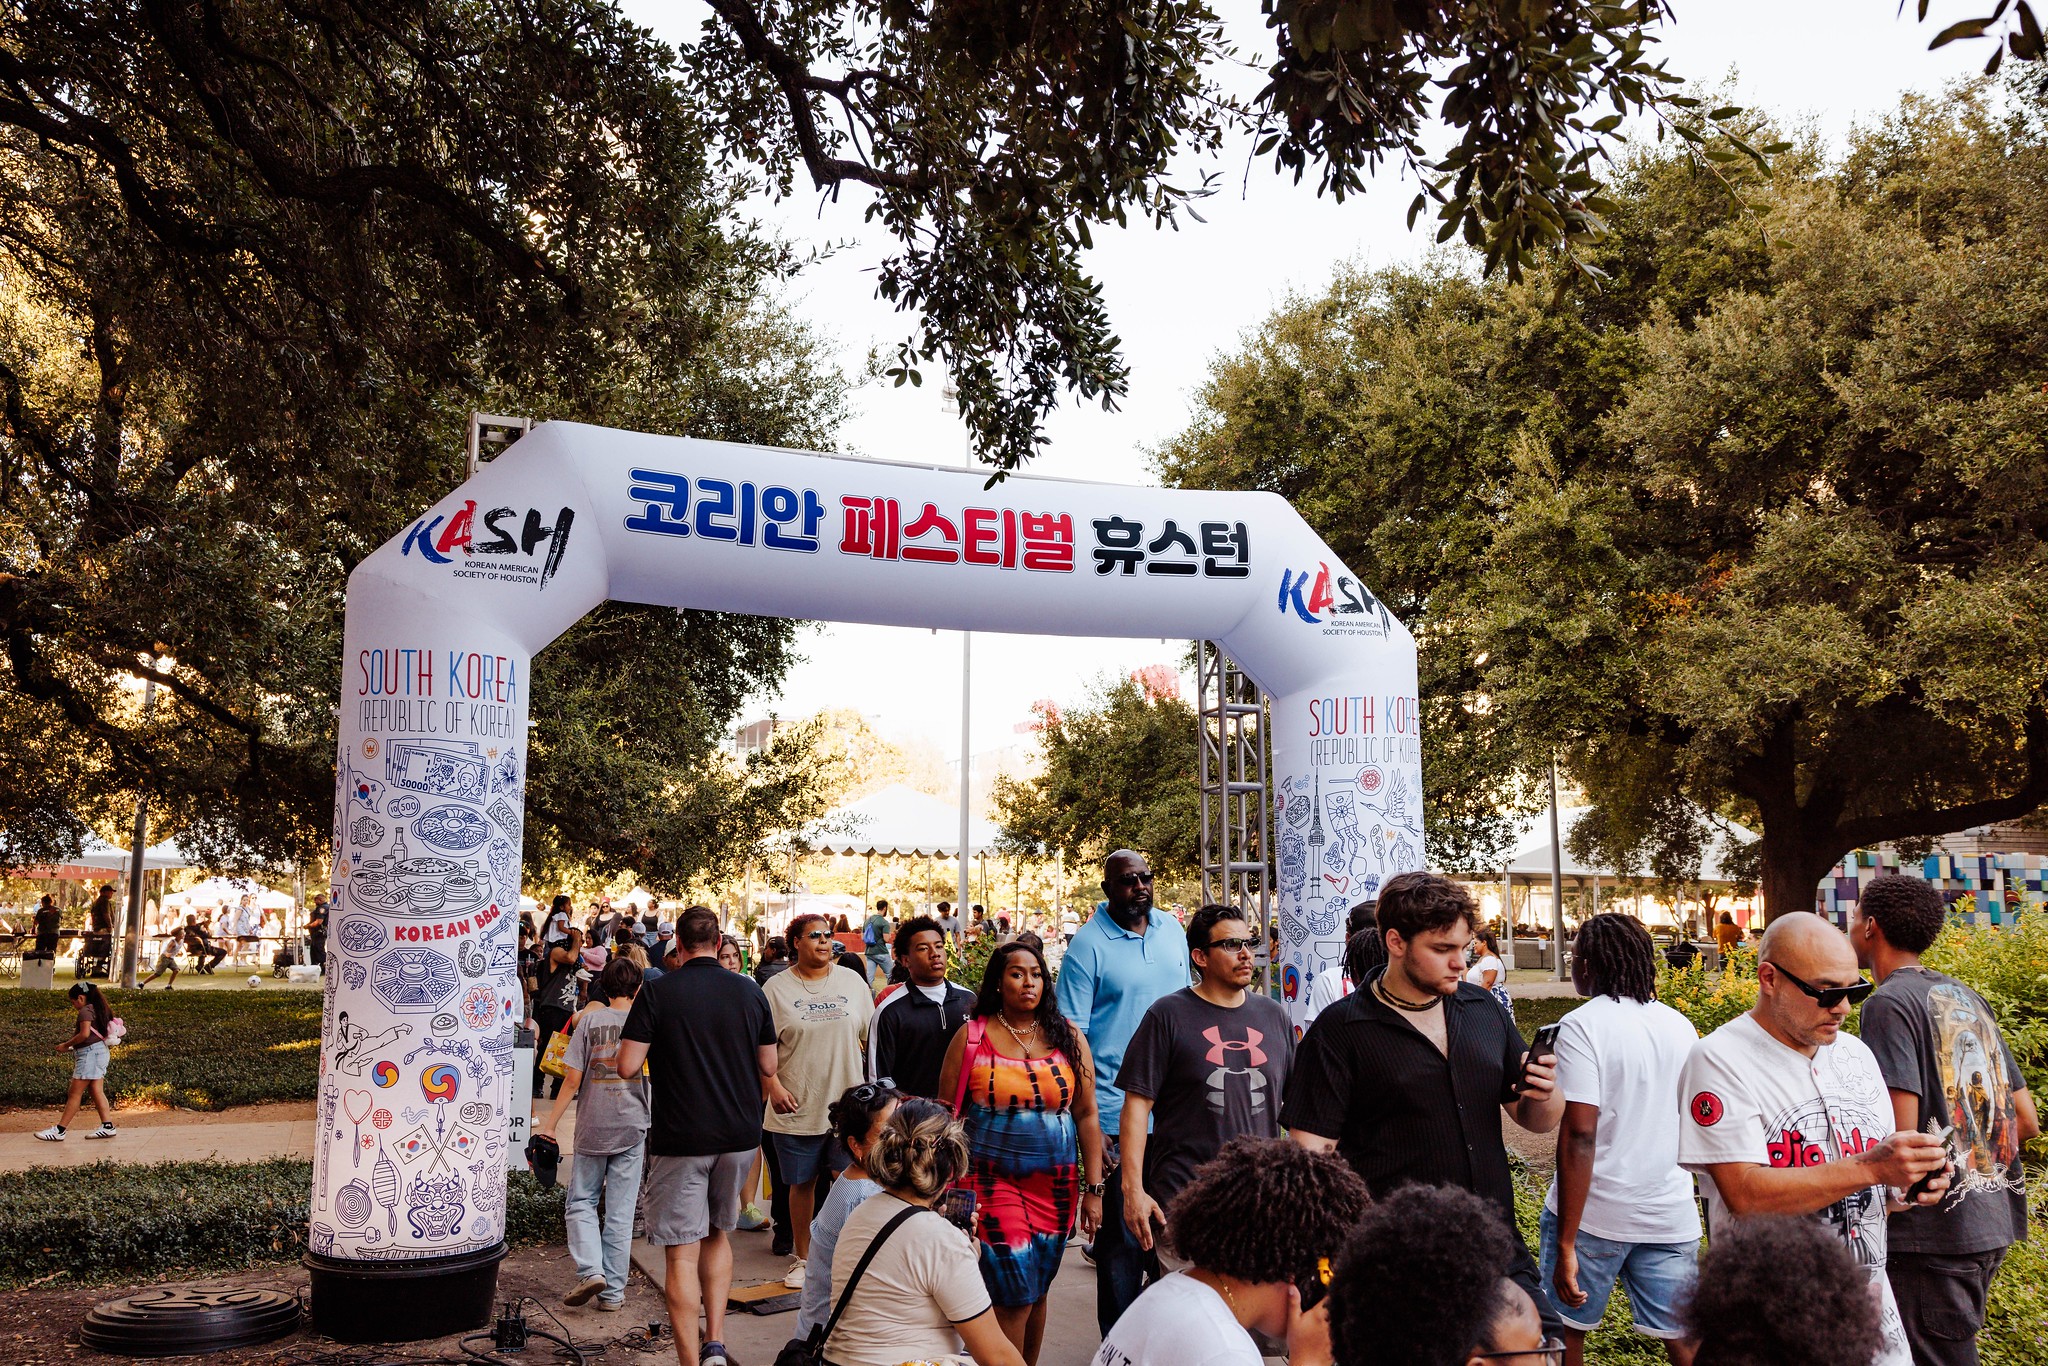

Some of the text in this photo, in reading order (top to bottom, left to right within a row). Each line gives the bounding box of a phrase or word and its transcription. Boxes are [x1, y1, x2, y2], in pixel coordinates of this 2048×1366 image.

[623, 467, 1251, 579] 코리안 페스티벌 휴스턴
[401, 500, 575, 592] KASH
[453, 570, 538, 584] SOCIETY OF HOUSTON
[464, 561, 539, 574] KOREAN AMERICAN
[1355, 621, 1381, 629] AMERICAN
[358, 648, 516, 704] SOUTH KOREA
[358, 699, 515, 739] (REPUBLIC OF KOREA)
[1309, 696, 1418, 737] SOUTH KORE
[1310, 737, 1378, 766] (REPUBLIC
[1383, 736, 1396, 763] OF
[400, 778, 429, 791] 50000
[401, 802, 416, 811] 500
[394, 903, 501, 942] KOREAN BBQ
[808, 1003, 836, 1011] Polo
